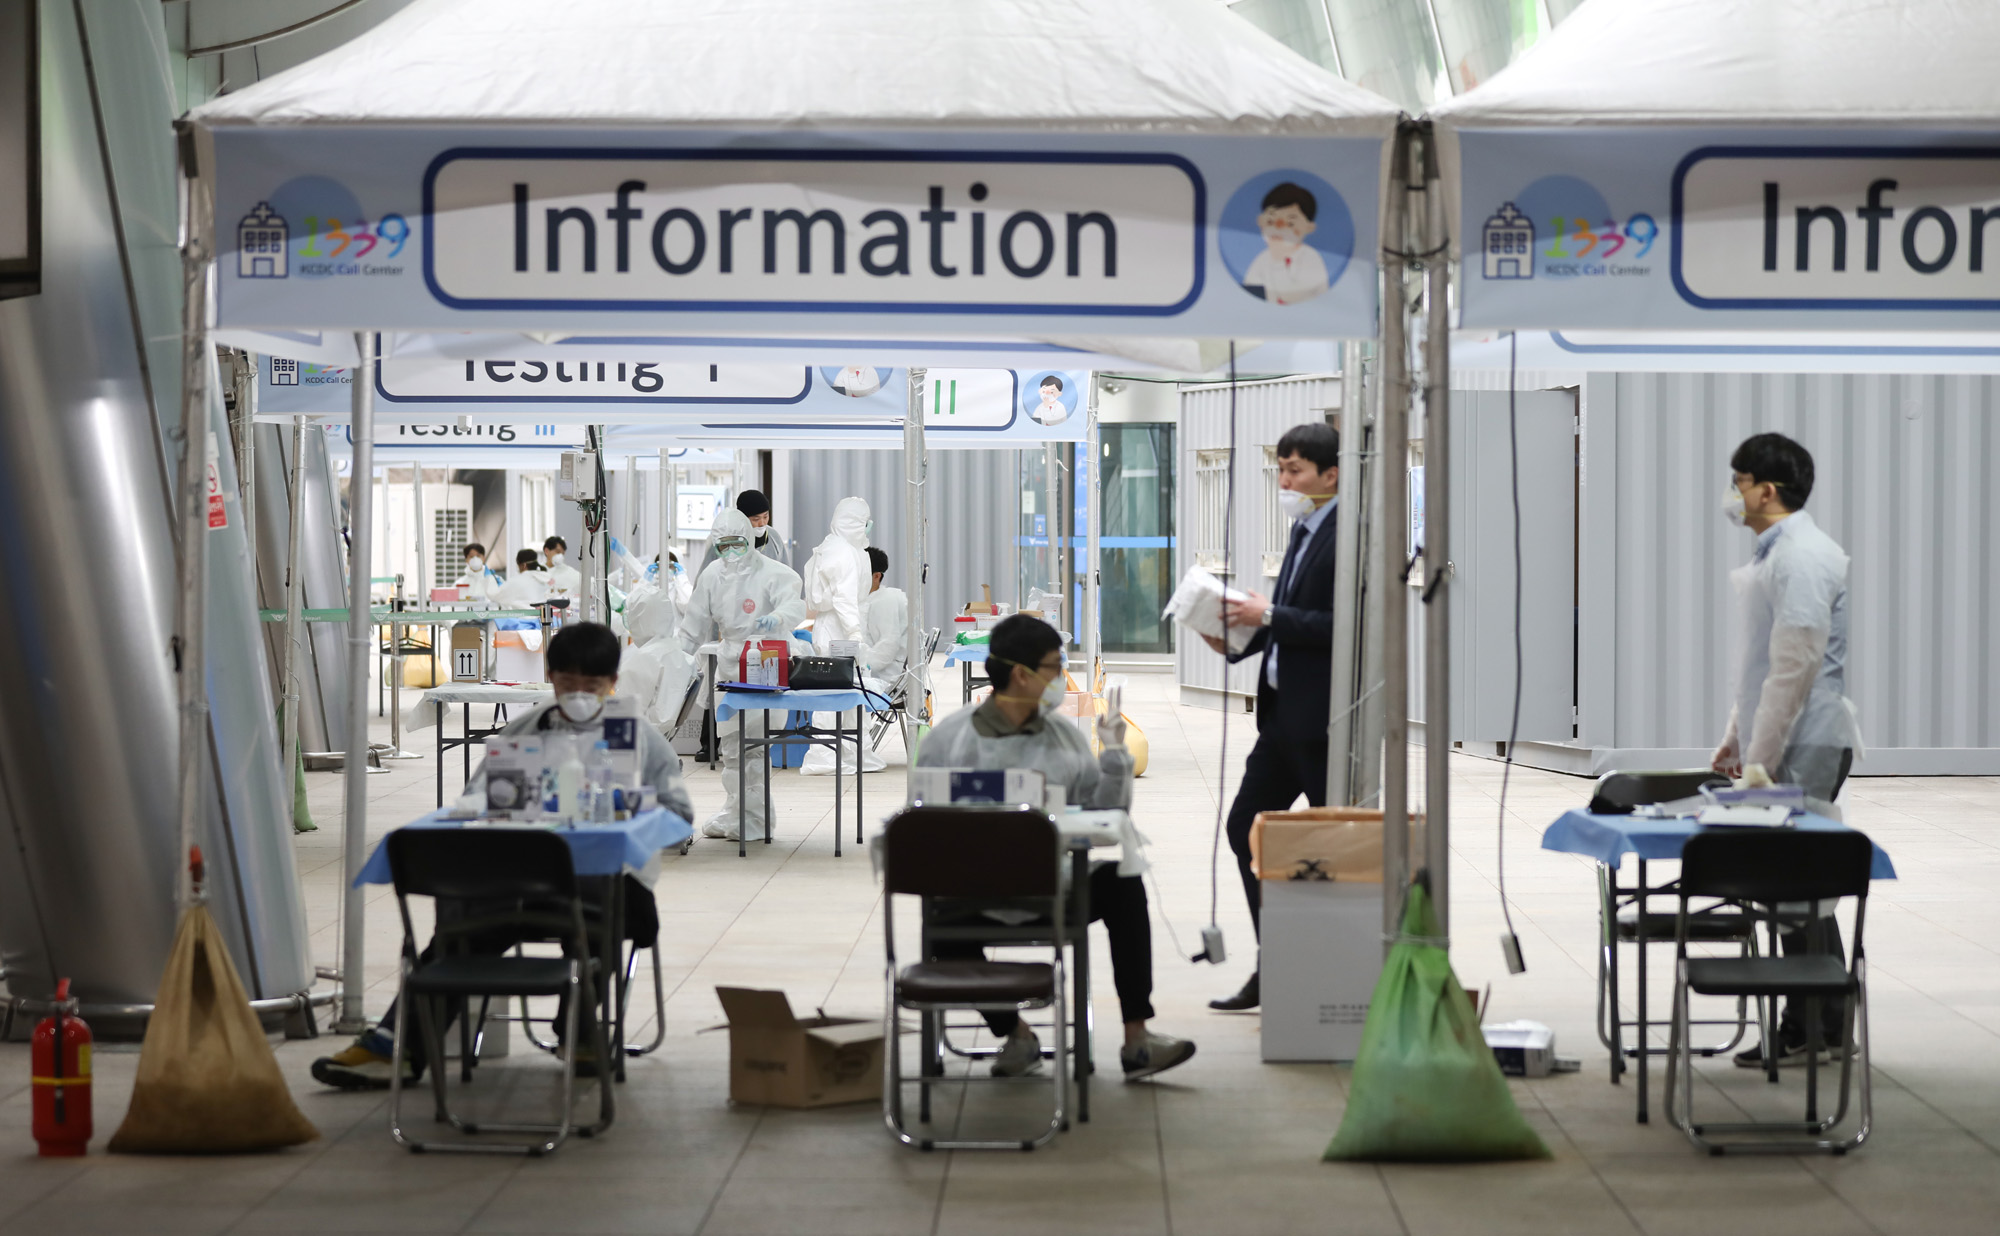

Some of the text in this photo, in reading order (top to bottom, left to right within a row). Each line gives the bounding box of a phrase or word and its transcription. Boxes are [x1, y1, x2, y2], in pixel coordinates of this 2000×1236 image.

[298, 214, 410, 258] 1339
[512, 179, 1116, 277] Information
[1545, 213, 1658, 259] 1339
[1763, 178, 2000, 275] Infor
[300, 264, 403, 276] KCDC Call Center
[1545, 264, 1650, 276] KCDC Call Center
[326, 376, 339, 384] Call
